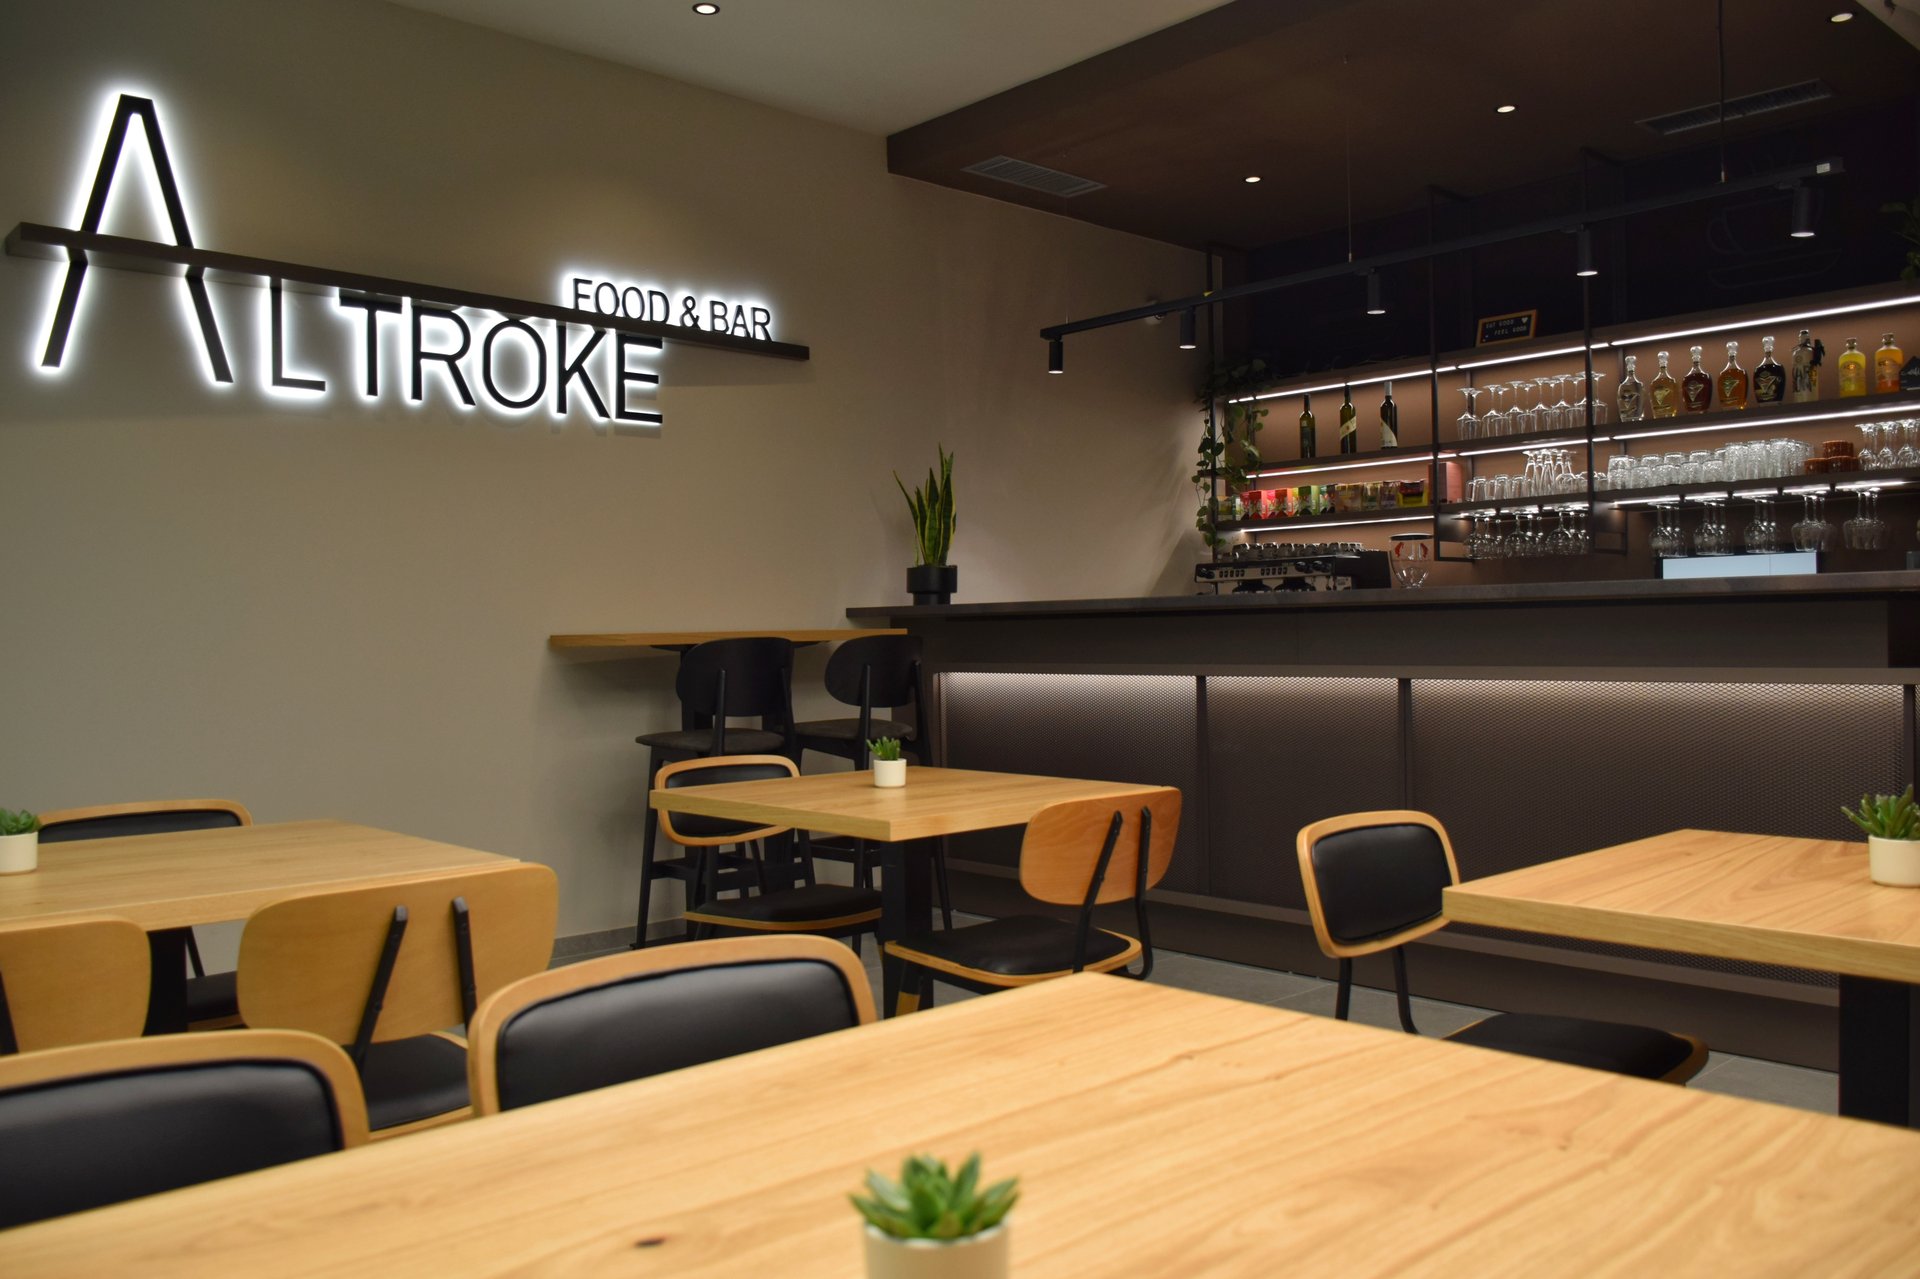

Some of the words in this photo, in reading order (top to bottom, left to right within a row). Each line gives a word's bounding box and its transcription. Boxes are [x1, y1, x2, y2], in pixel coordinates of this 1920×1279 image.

[40, 93, 664, 424] ALTROKE
[573, 278, 669, 324] FOOD
[680, 296, 701, 329] &
[709, 300, 773, 342] BAR
